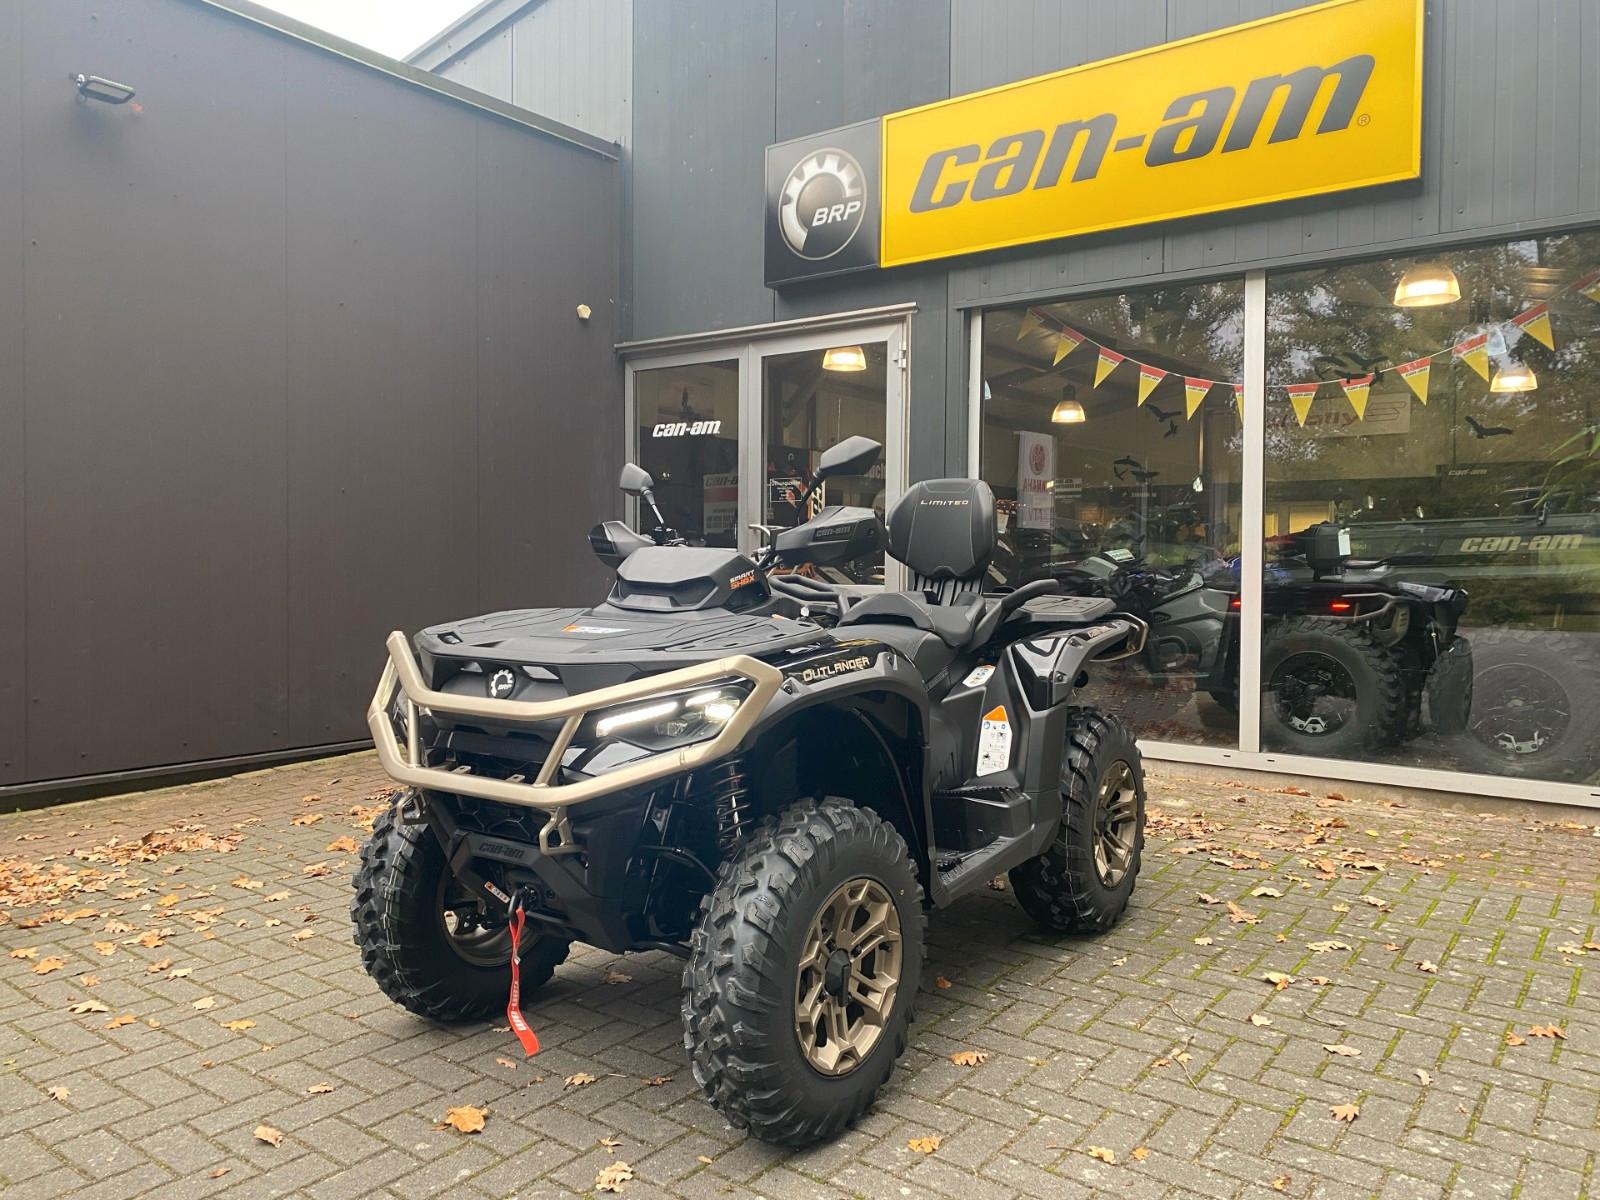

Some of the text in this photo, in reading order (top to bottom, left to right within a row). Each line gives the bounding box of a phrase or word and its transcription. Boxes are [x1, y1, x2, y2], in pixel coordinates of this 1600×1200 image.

[908, 53, 1375, 214] can-am
[811, 200, 861, 228] BRP
[652, 420, 721, 438] can-am
[1460, 533, 1585, 552] can-am
[729, 569, 755, 583] SMART
[802, 656, 870, 682] OUTLANDER
